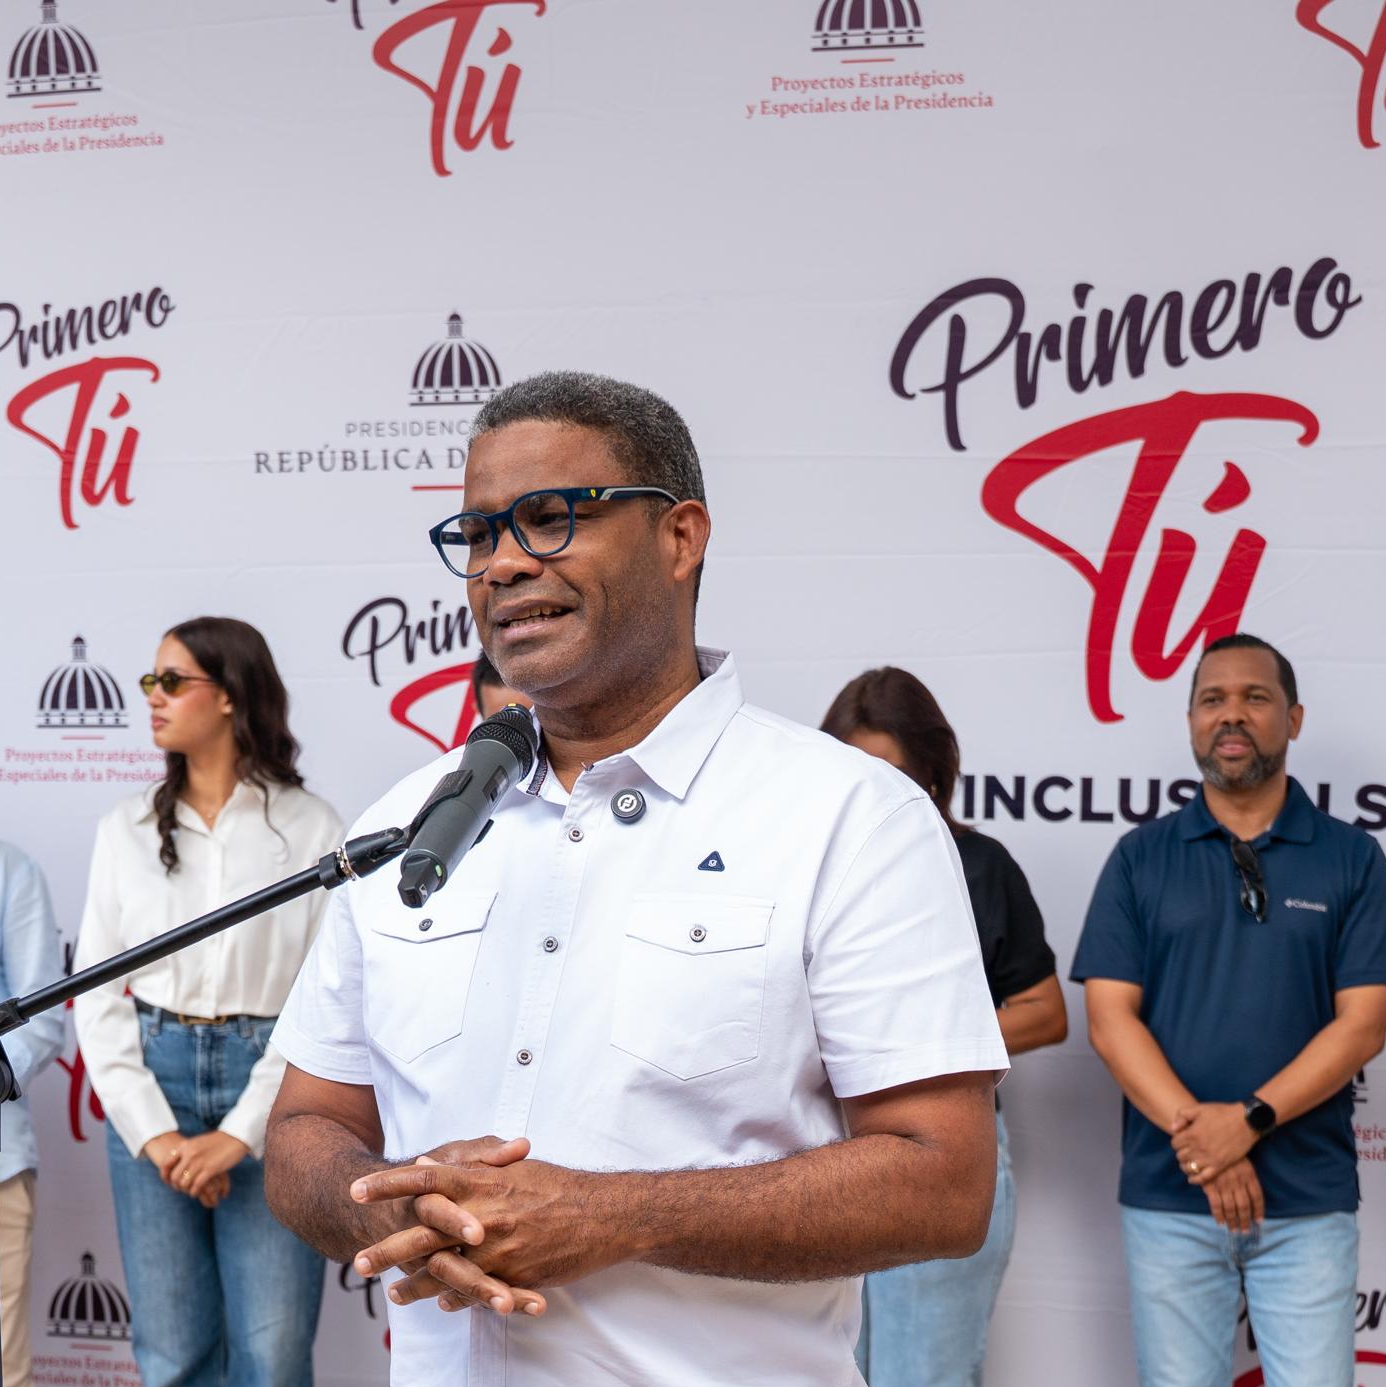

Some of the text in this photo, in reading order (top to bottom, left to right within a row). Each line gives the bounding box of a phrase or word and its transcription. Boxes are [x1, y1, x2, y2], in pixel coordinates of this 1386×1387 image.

[372, 0, 547, 178] Tú
[772, 70, 966, 94] Proyectos Estratégicos
[746, 91, 994, 119] y Especiales de la Presidencia
[48, 112, 138, 132] Estratégicos
[42, 138, 60, 153] de
[63, 137, 76, 151] la
[79, 131, 164, 150] Presidencia
[889, 257, 1363, 451] Primero
[7, 356, 161, 530] Tú
[345, 420, 471, 438] PRESIDENC
[254, 445, 434, 474] REPÚBLICA
[980, 390, 1321, 724] Tú
[342, 597, 474, 687] Prim
[72, 768, 85, 782] de
[90, 768, 103, 782] la
[106, 768, 166, 783] Presiden
